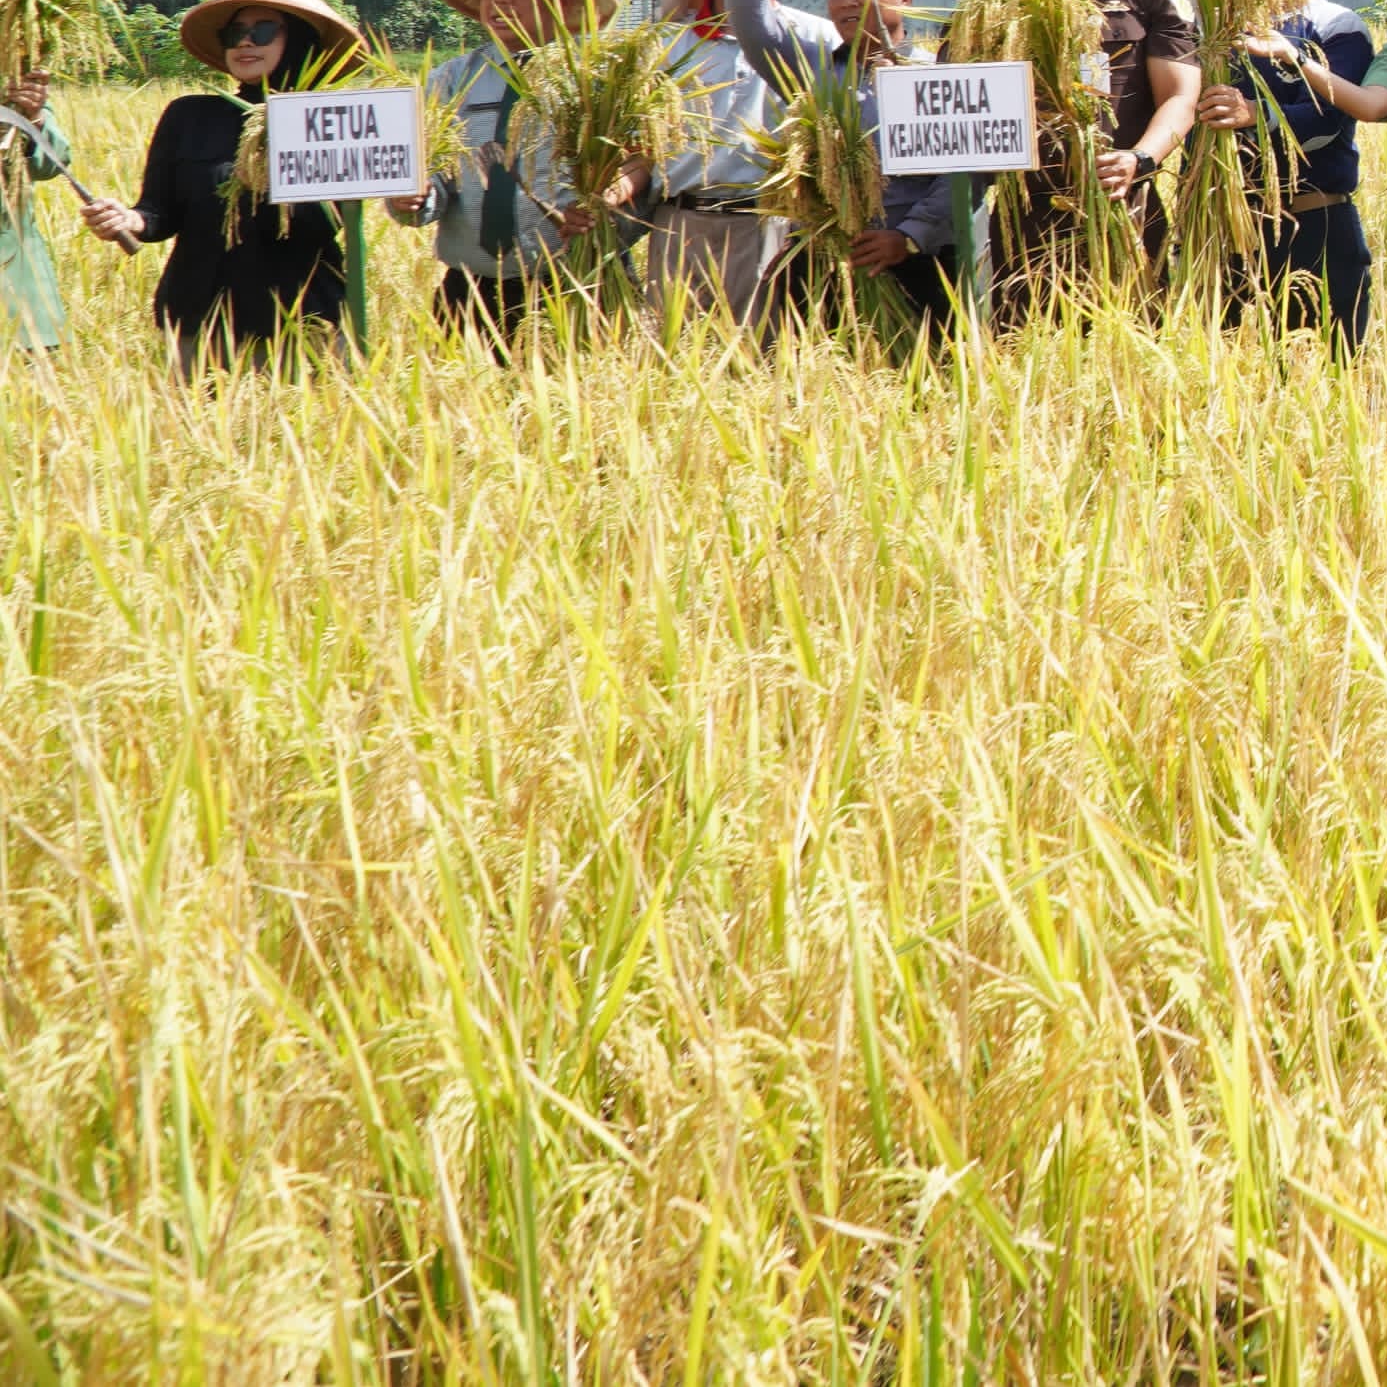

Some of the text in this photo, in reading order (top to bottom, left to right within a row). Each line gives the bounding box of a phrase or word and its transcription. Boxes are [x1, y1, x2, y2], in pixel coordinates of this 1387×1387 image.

[914, 78, 991, 116] KEPALA
[304, 104, 379, 142] KETUA
[888, 118, 1023, 158] KEJAKSAAN NEGERI
[279, 144, 410, 185] PENGADILAN NEGERI
